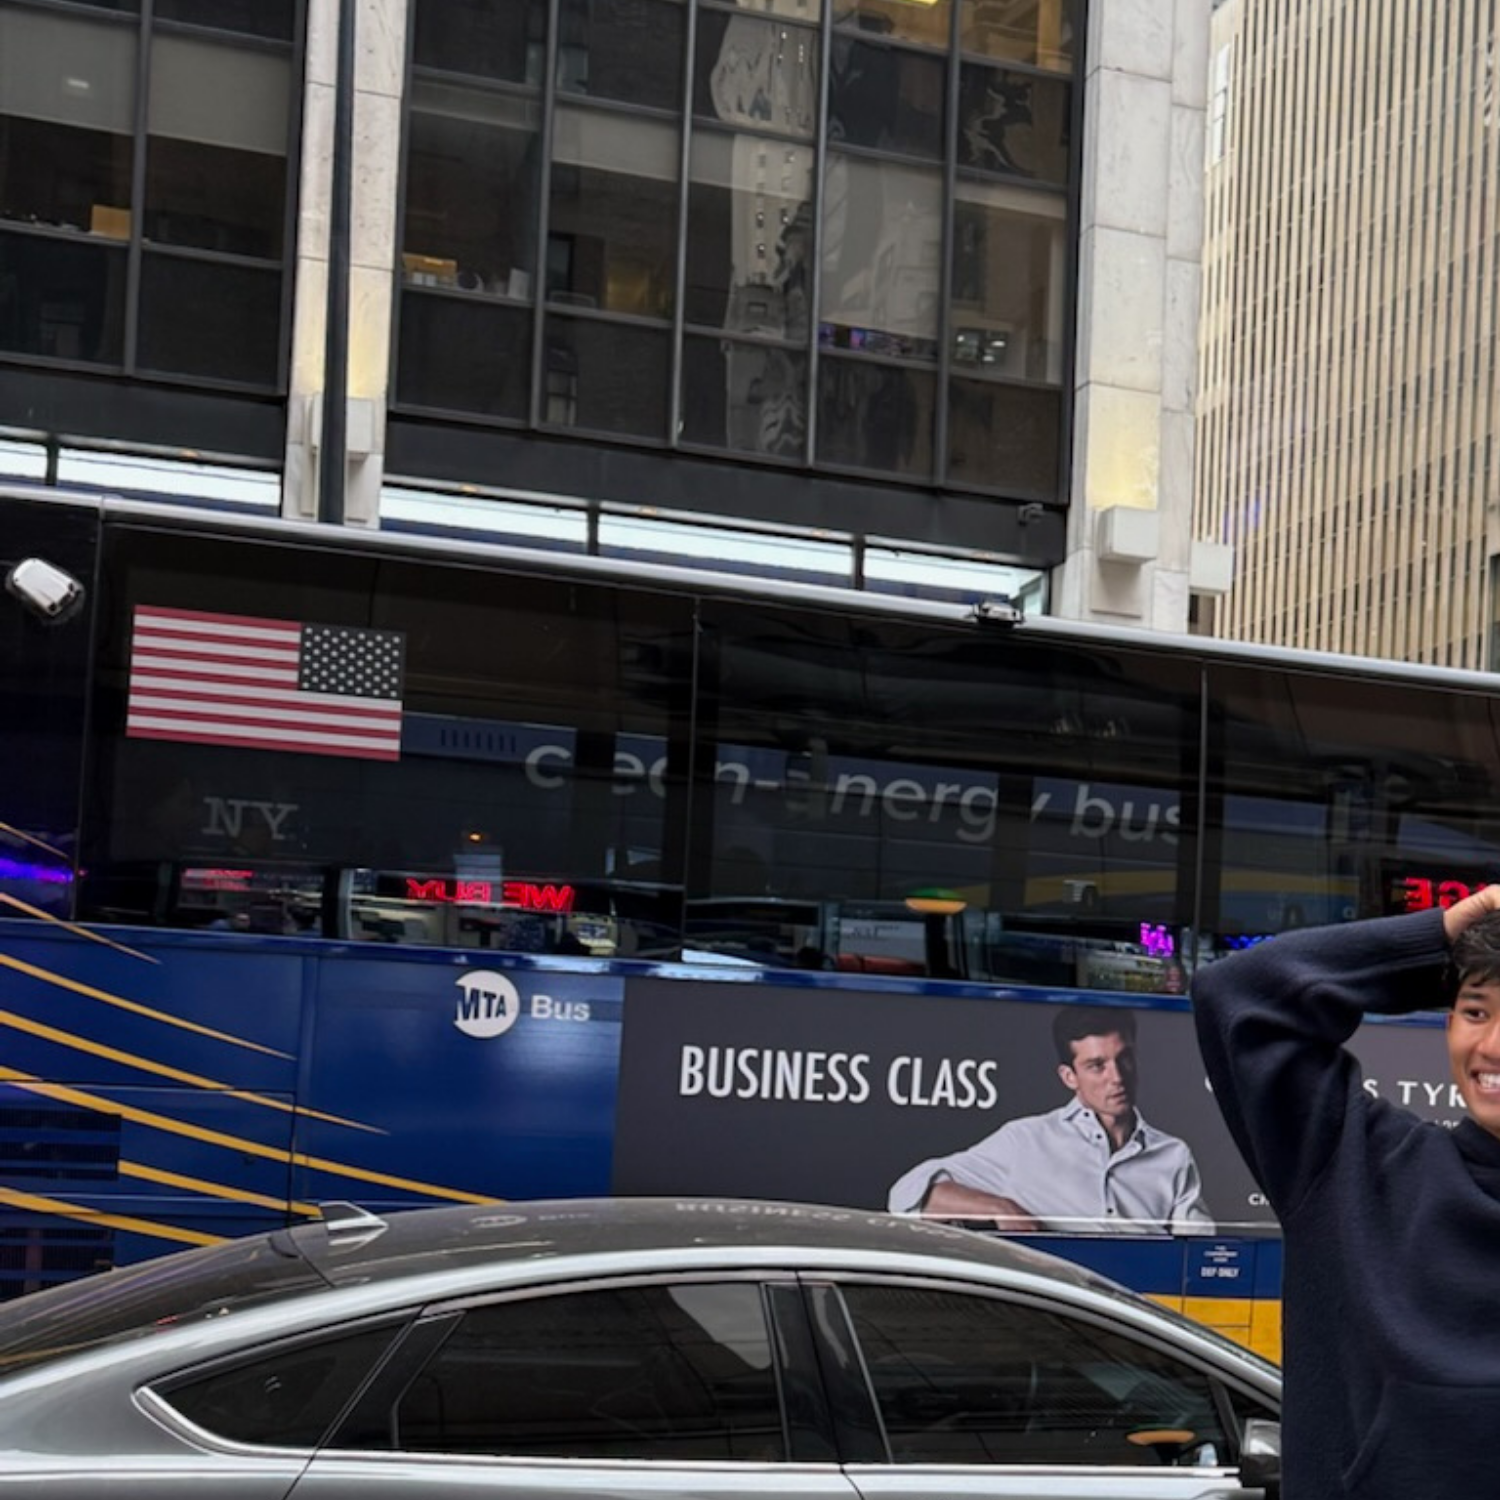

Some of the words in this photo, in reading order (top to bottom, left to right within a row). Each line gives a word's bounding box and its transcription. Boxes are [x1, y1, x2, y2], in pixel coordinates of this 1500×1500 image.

[200, 796, 300, 841] NY
[524, 743, 1051, 844] cen-energ
[530, 995, 591, 1021] Bus
[679, 1045, 870, 1104] BUSINESS
[886, 1056, 998, 1109] CLASS
